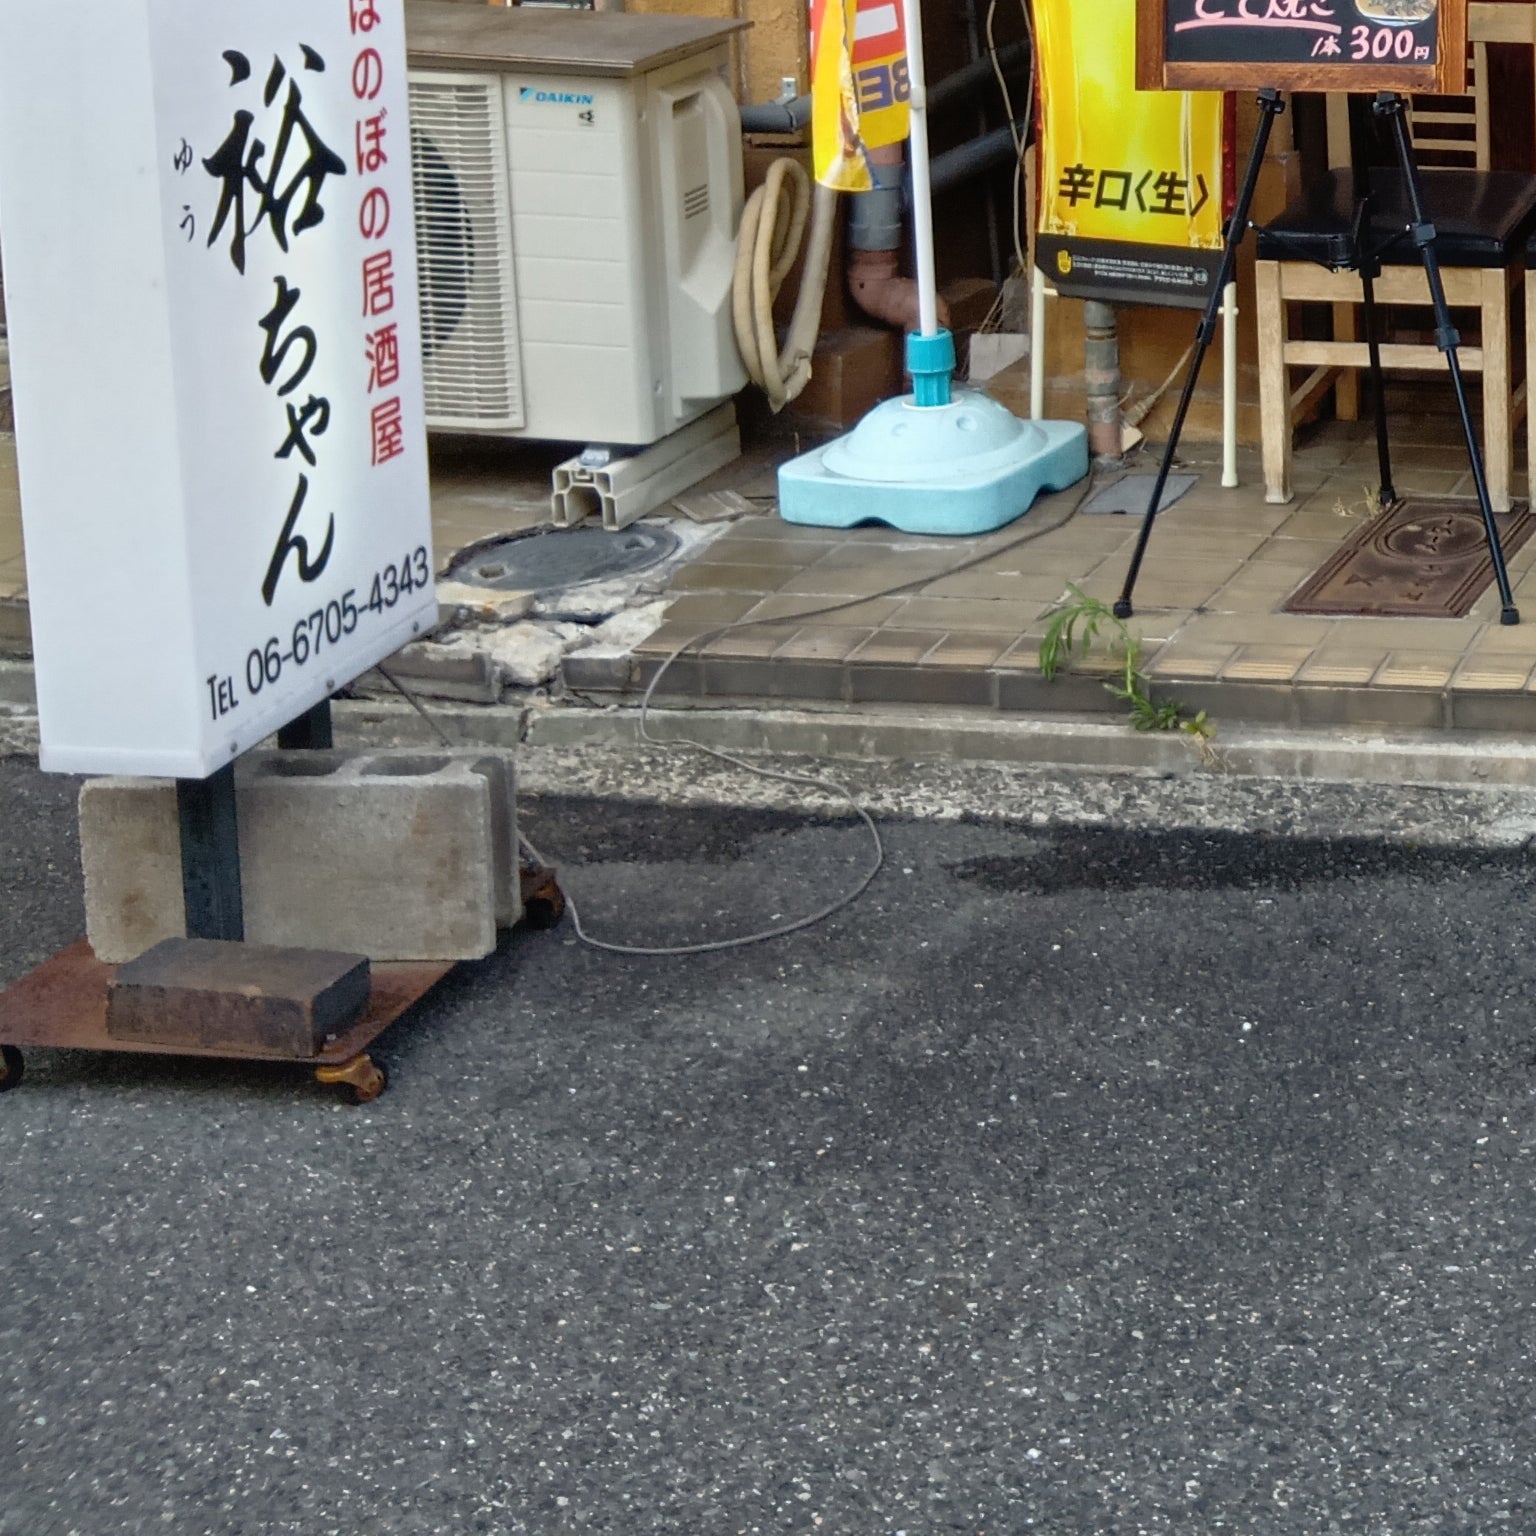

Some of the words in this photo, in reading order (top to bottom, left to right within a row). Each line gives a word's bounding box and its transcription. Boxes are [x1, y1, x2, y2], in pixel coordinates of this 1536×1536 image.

[1310, 35, 1343, 57] 1本
[1350, 25, 1430, 60] 300円
[535, 91, 594, 106] DAIKIN
[172, 136, 195, 244] ゆう
[202, 42, 347, 607] 裕ちゃん
[206, 674, 240, 722] TEL
[246, 544, 431, 696] 06-6705-4343
